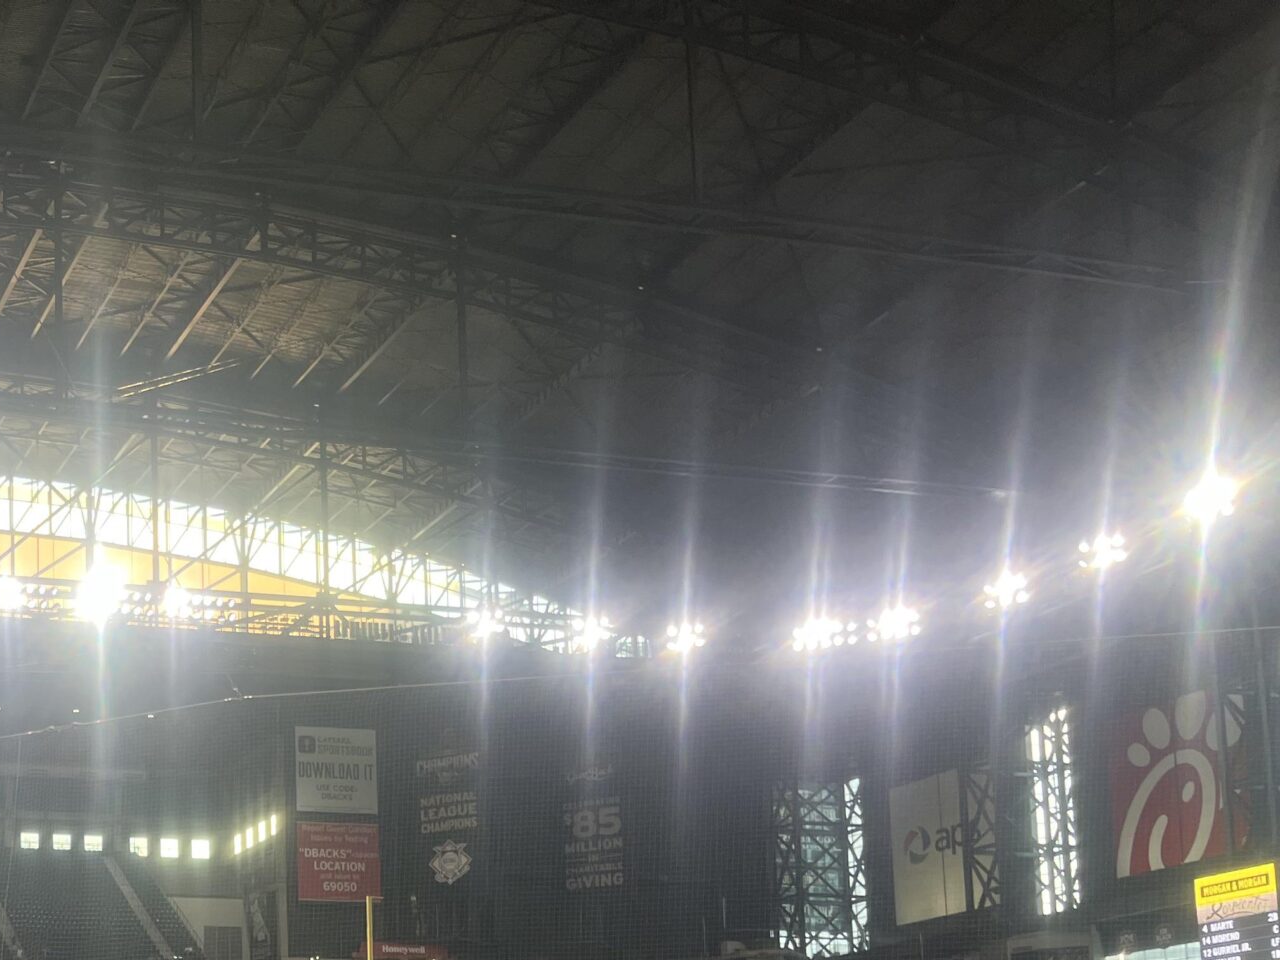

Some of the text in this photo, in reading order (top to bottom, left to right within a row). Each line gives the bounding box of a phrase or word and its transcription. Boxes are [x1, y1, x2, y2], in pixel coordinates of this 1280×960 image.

[298, 761, 374, 781] DOWNLOAD IT
[420, 791, 477, 807] NATIONAL
[420, 802, 477, 820] LEAGUE
[421, 816, 478, 834] CHAMPIONS
[565, 838, 623, 853] MILLION
[313, 860, 366, 872] LOCATION
[323, 881, 357, 892] 69050
[566, 872, 624, 889] GIVING
[1203, 880, 1231, 897] MORGAN
[1238, 874, 1267, 889] MORGAN
[1210, 920, 1233, 932] MARTE
[1211, 931, 1240, 944] MORENO
[382, 945, 425, 955] Honeywell
[1203, 949, 1212, 958] 12
